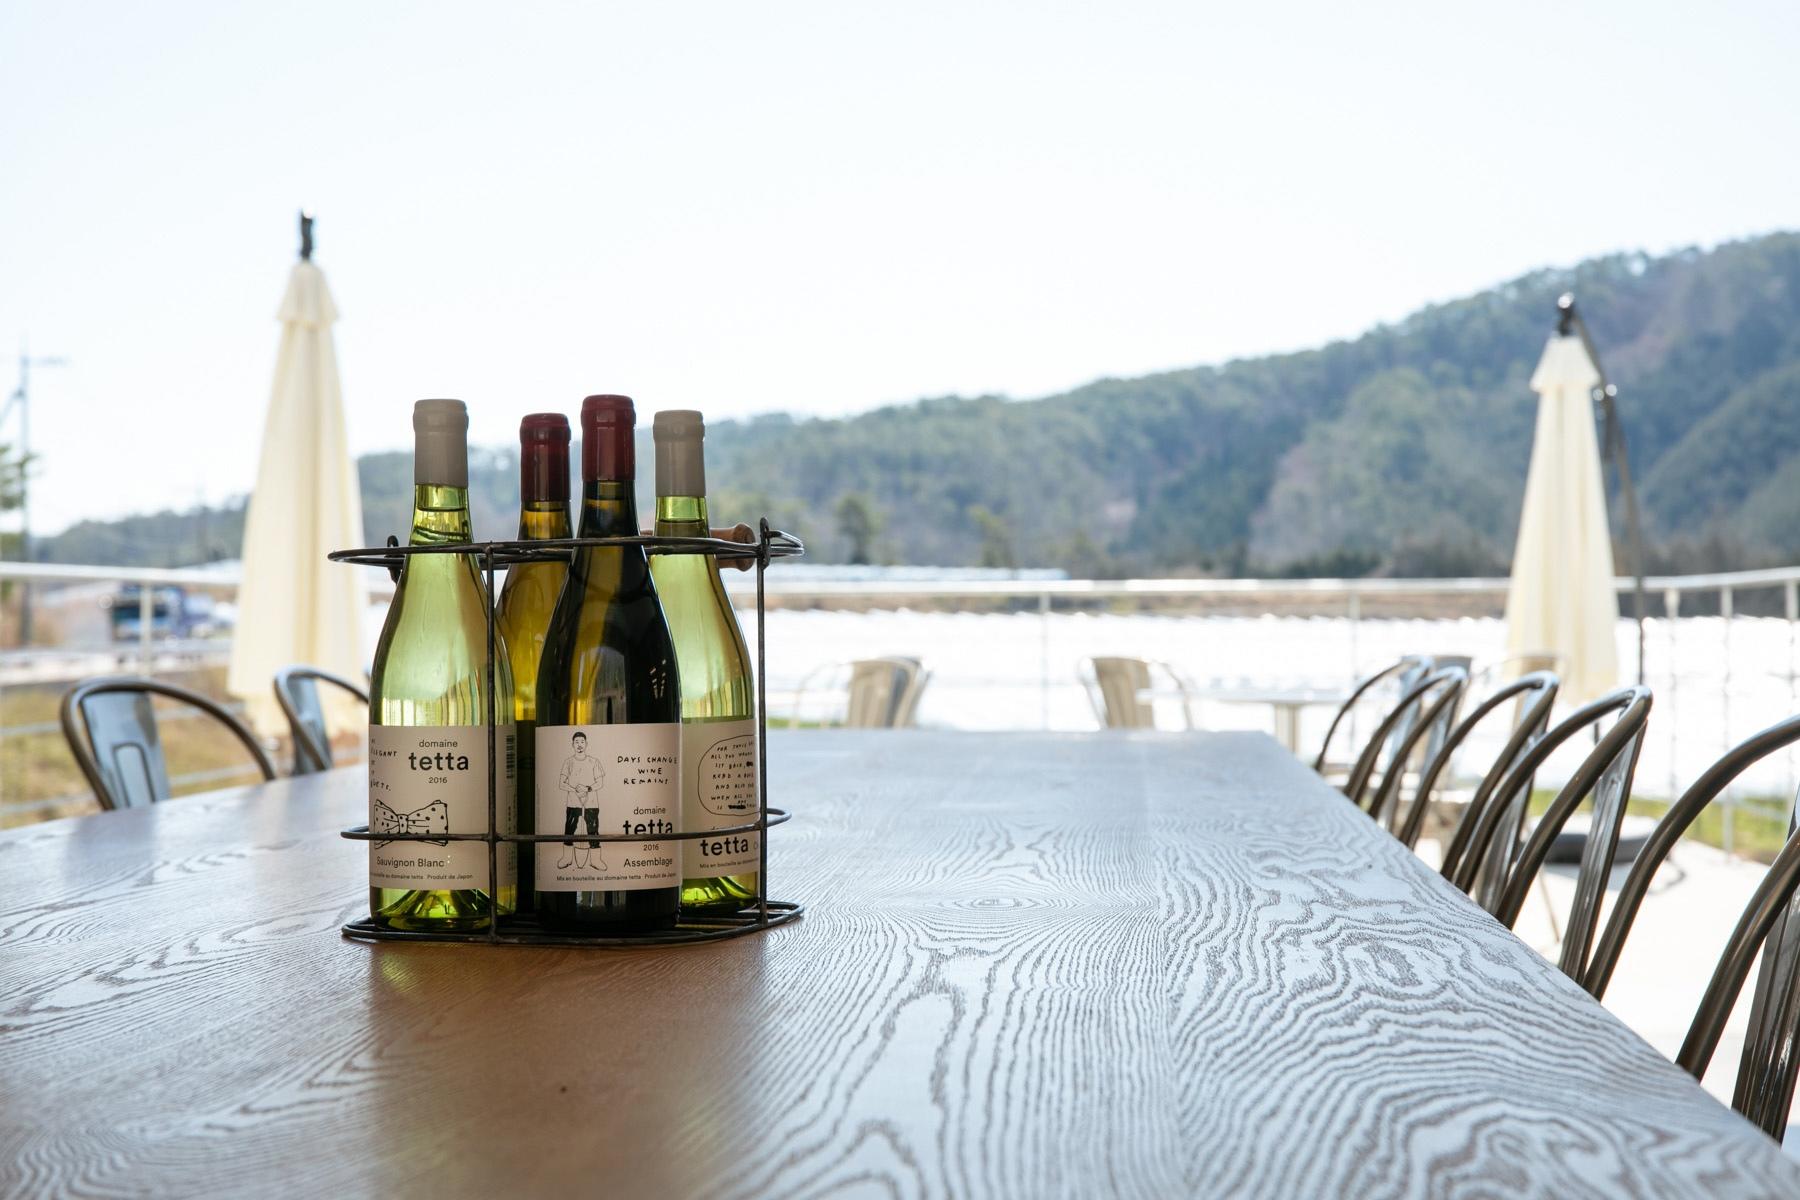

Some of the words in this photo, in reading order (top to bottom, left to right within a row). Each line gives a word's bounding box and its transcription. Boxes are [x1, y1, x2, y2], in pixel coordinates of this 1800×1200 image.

[419, 739, 459, 748] domaine
[408, 752, 469, 771] tetta
[647, 756, 677, 764] CHANGE
[638, 767, 662, 775] WINE
[633, 806, 666, 815] domaine
[622, 819, 673, 835] tetta
[700, 836, 749, 856] tetta
[377, 856, 415, 868] Sauvignon
[418, 858, 445, 867] Blanc
[623, 858, 673, 867] Assemblage
